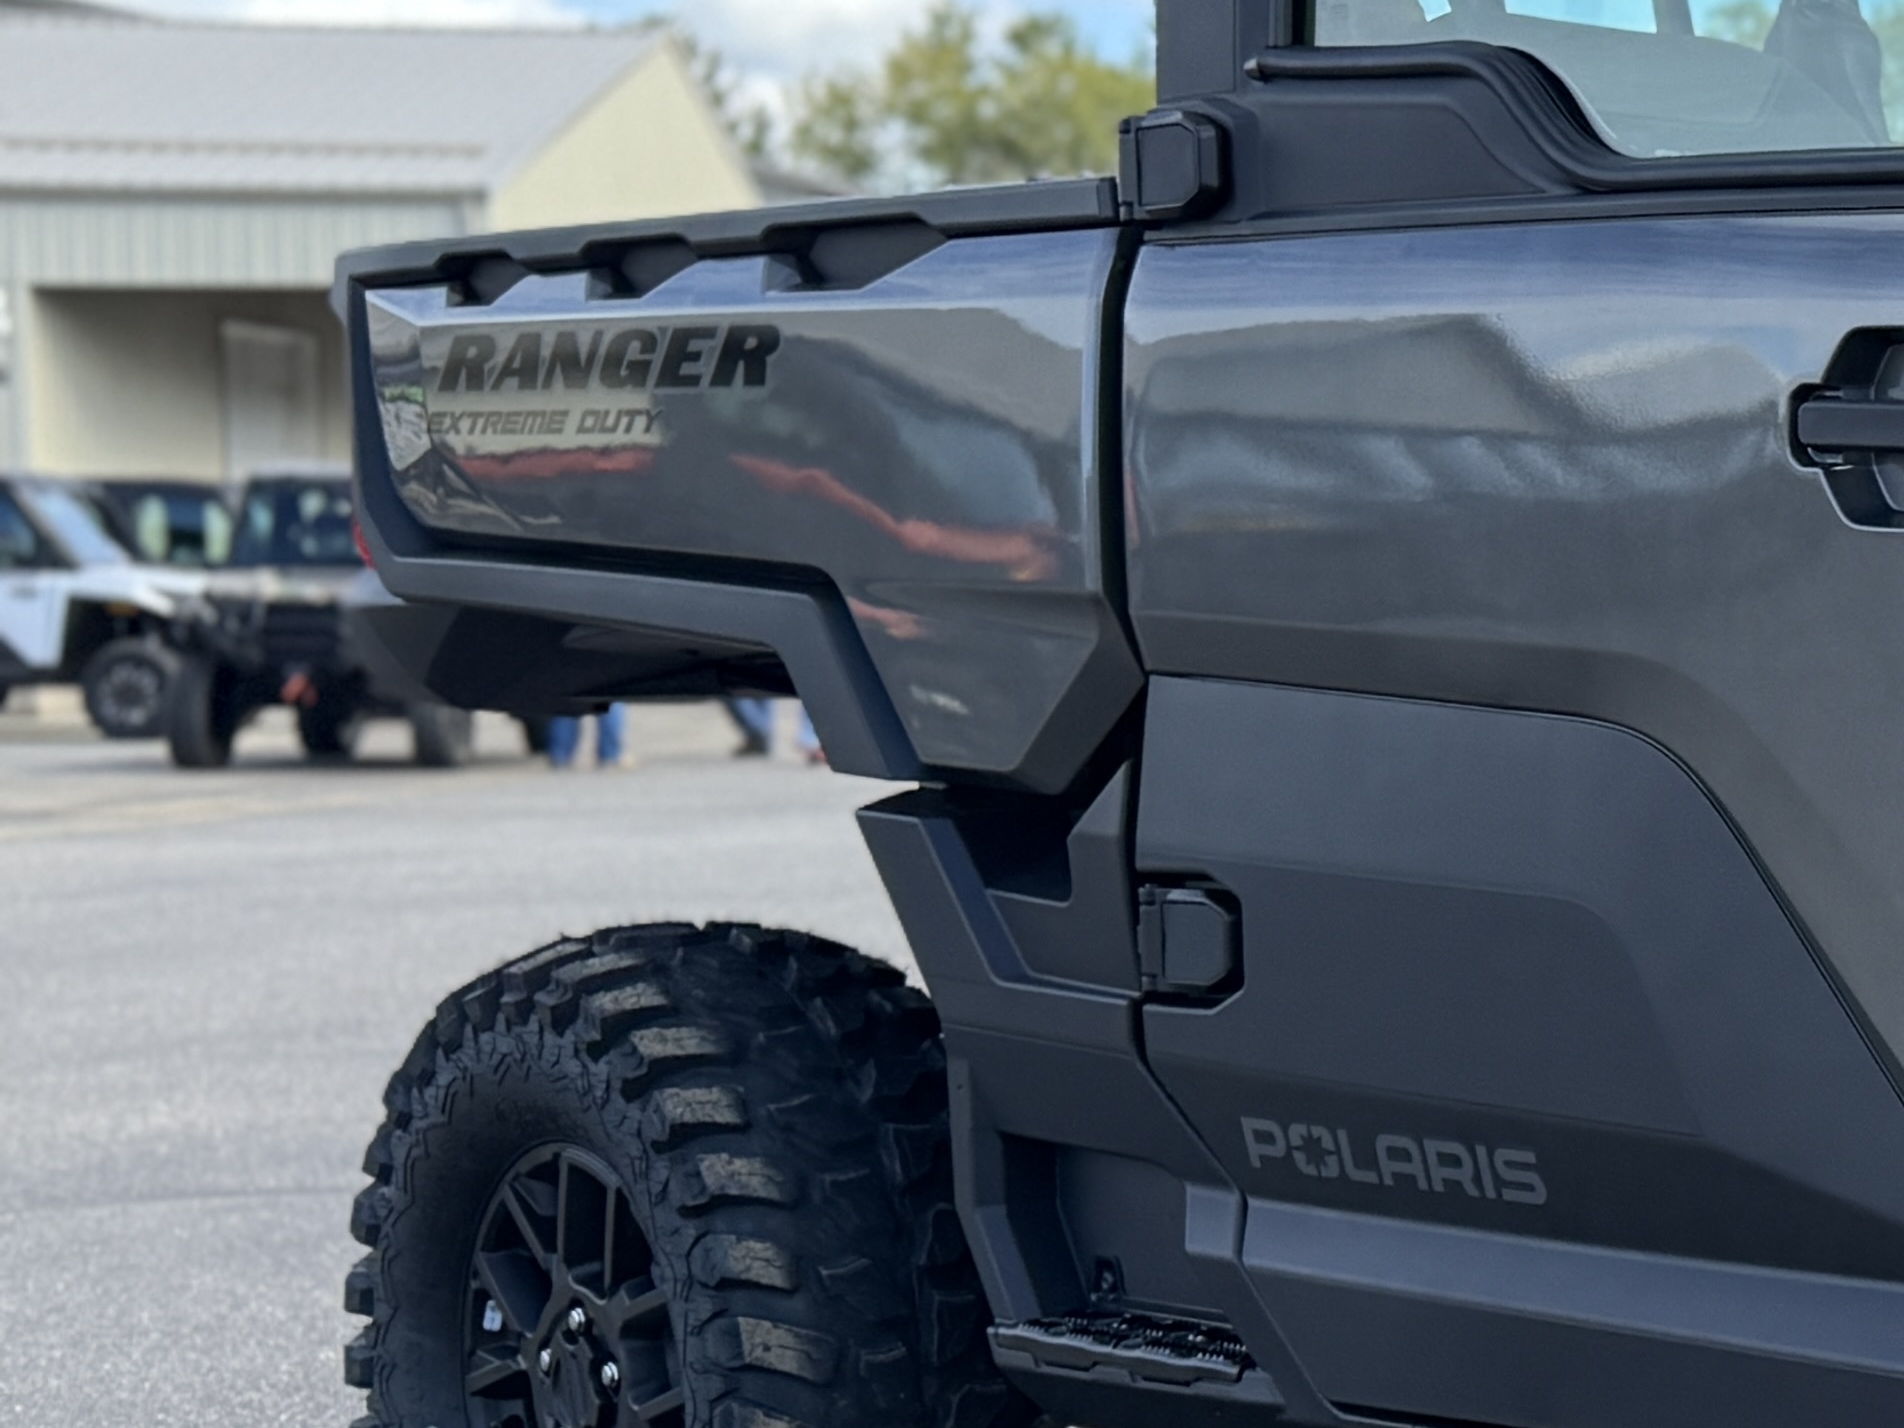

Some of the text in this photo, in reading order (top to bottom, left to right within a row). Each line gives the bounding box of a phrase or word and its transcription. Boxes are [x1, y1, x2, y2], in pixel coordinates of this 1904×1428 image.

[436, 323, 781, 392] RANGER
[426, 407, 662, 436] EXTREME DUTY
[1241, 1115, 1548, 1205] POLARIS
